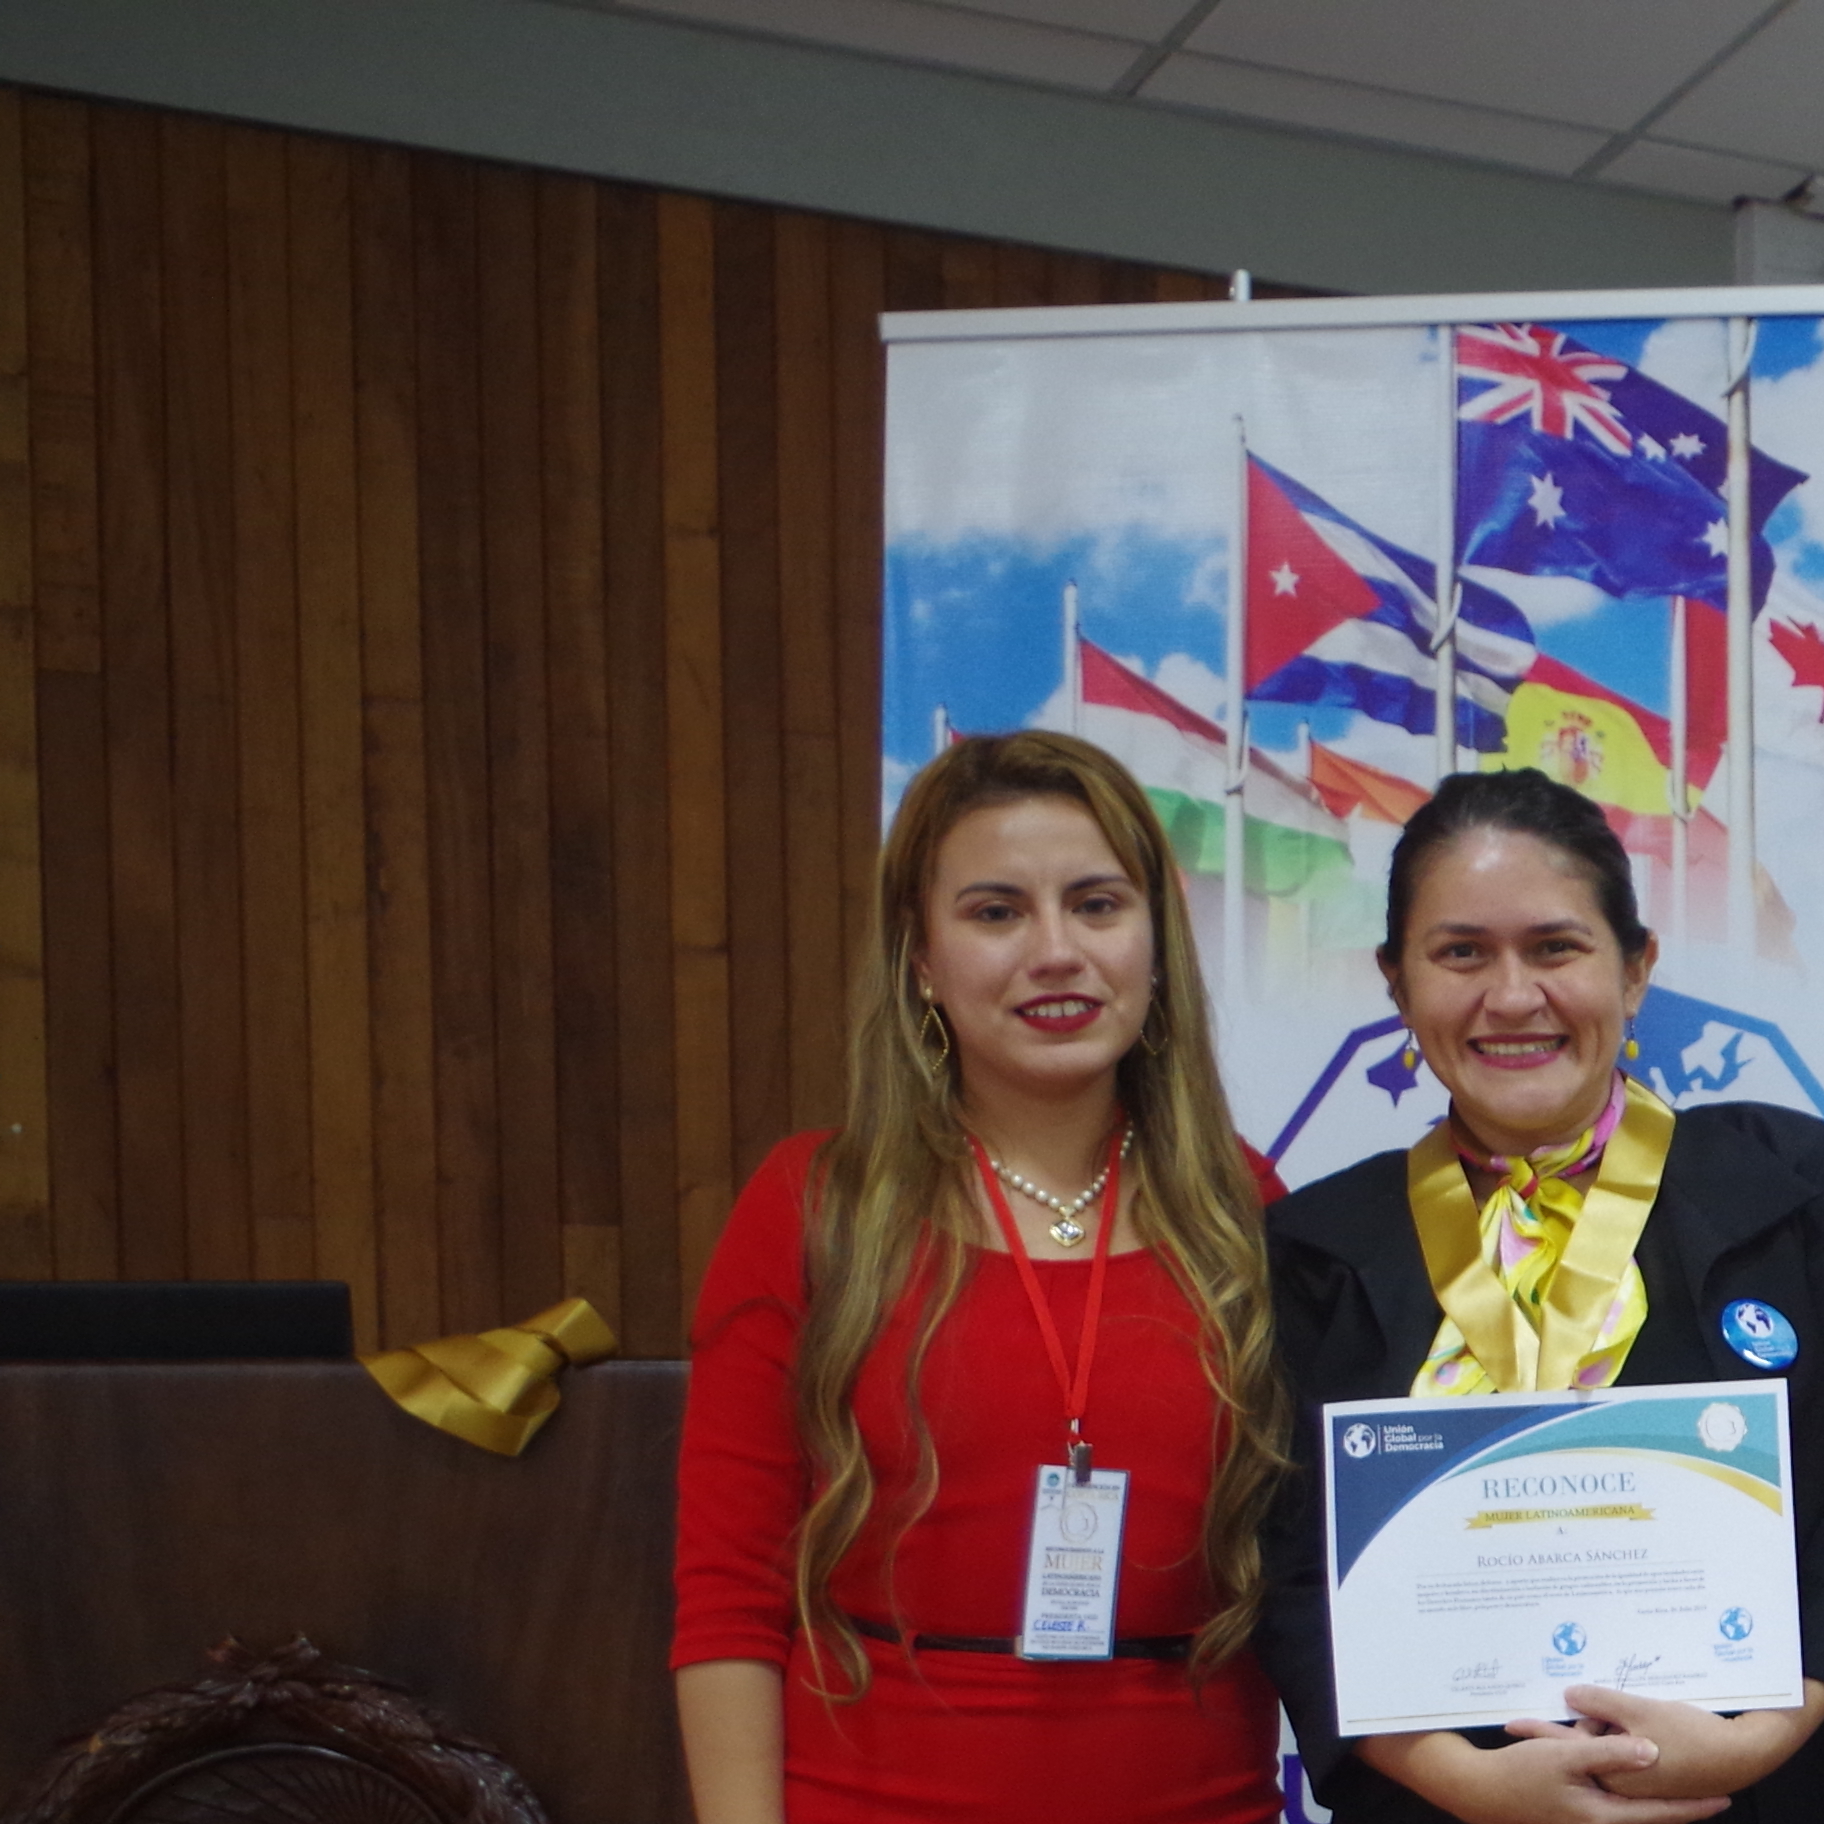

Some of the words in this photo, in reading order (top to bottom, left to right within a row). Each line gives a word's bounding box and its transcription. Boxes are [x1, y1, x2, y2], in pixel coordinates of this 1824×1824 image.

[1383, 1424, 1414, 1434] Unión
[1384, 1432, 1417, 1443] Global
[1385, 1441, 1444, 1452] Democracia
[1482, 1472, 1636, 1500] RECONOCE
[1485, 1511, 1523, 1523] MUJER
[1526, 1505, 1636, 1520] LATINOAMERICANA
[1044, 1554, 1102, 1571] MUJER
